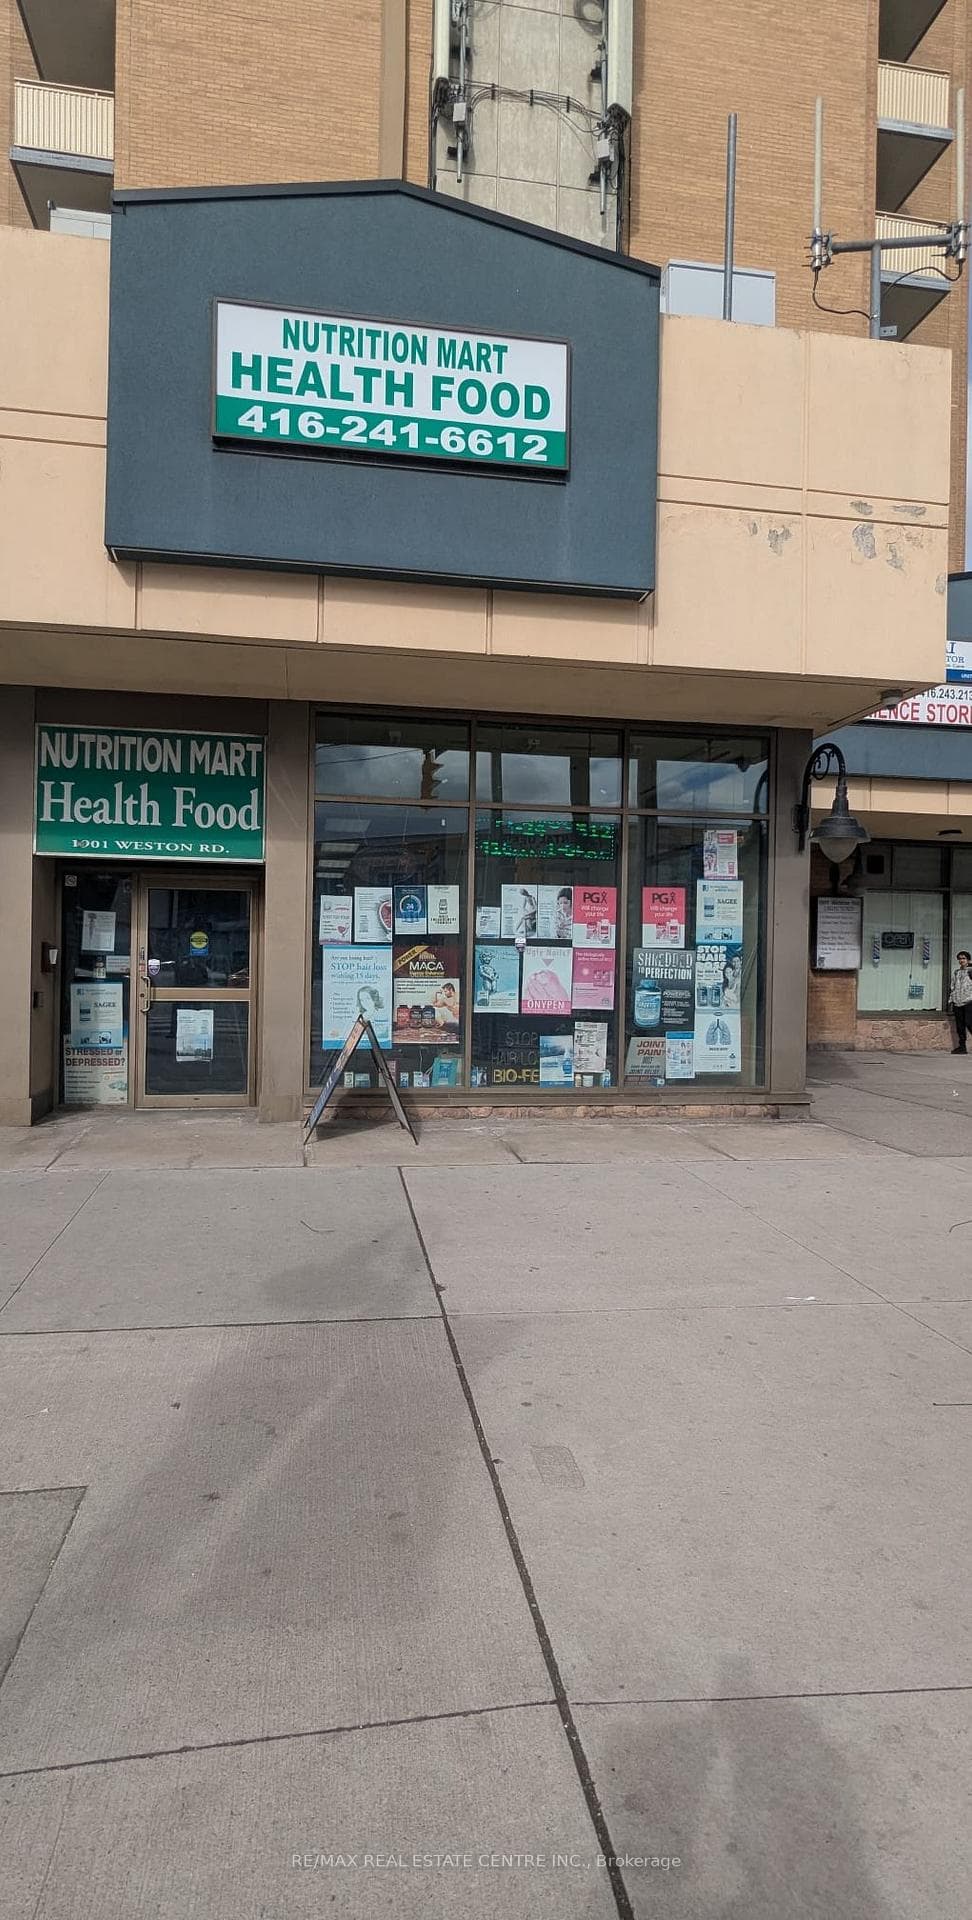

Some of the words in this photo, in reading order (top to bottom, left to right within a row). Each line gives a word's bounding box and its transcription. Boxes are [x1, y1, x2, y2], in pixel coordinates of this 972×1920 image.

[282, 318, 428, 366] NUTRITION
[437, 337, 509, 374] MART
[231, 351, 414, 408] HEALTH
[431, 375, 551, 421] FOOD
[237, 405, 548, 462] 416-241-6612
[40, 731, 182, 774] NUTRITION
[189, 740, 262, 777] MART
[39, 780, 162, 827] Health
[172, 787, 261, 831] Food
[72, 839, 108, 850] 1901
[115, 840, 193, 853] WESTON
[199, 843, 230, 854] RD.
[638, 952, 693, 968] SHREDDED
[696, 954, 727, 962] HAIR
[331, 962, 355, 970] STOP
[410, 961, 444, 971] MACA
[645, 968, 692, 980] PERFECTION
[527, 1000, 565, 1009] ONYPEN
[65, 1048, 114, 1056] STRESSED
[65, 1058, 126, 1067] DEPRESSED?
